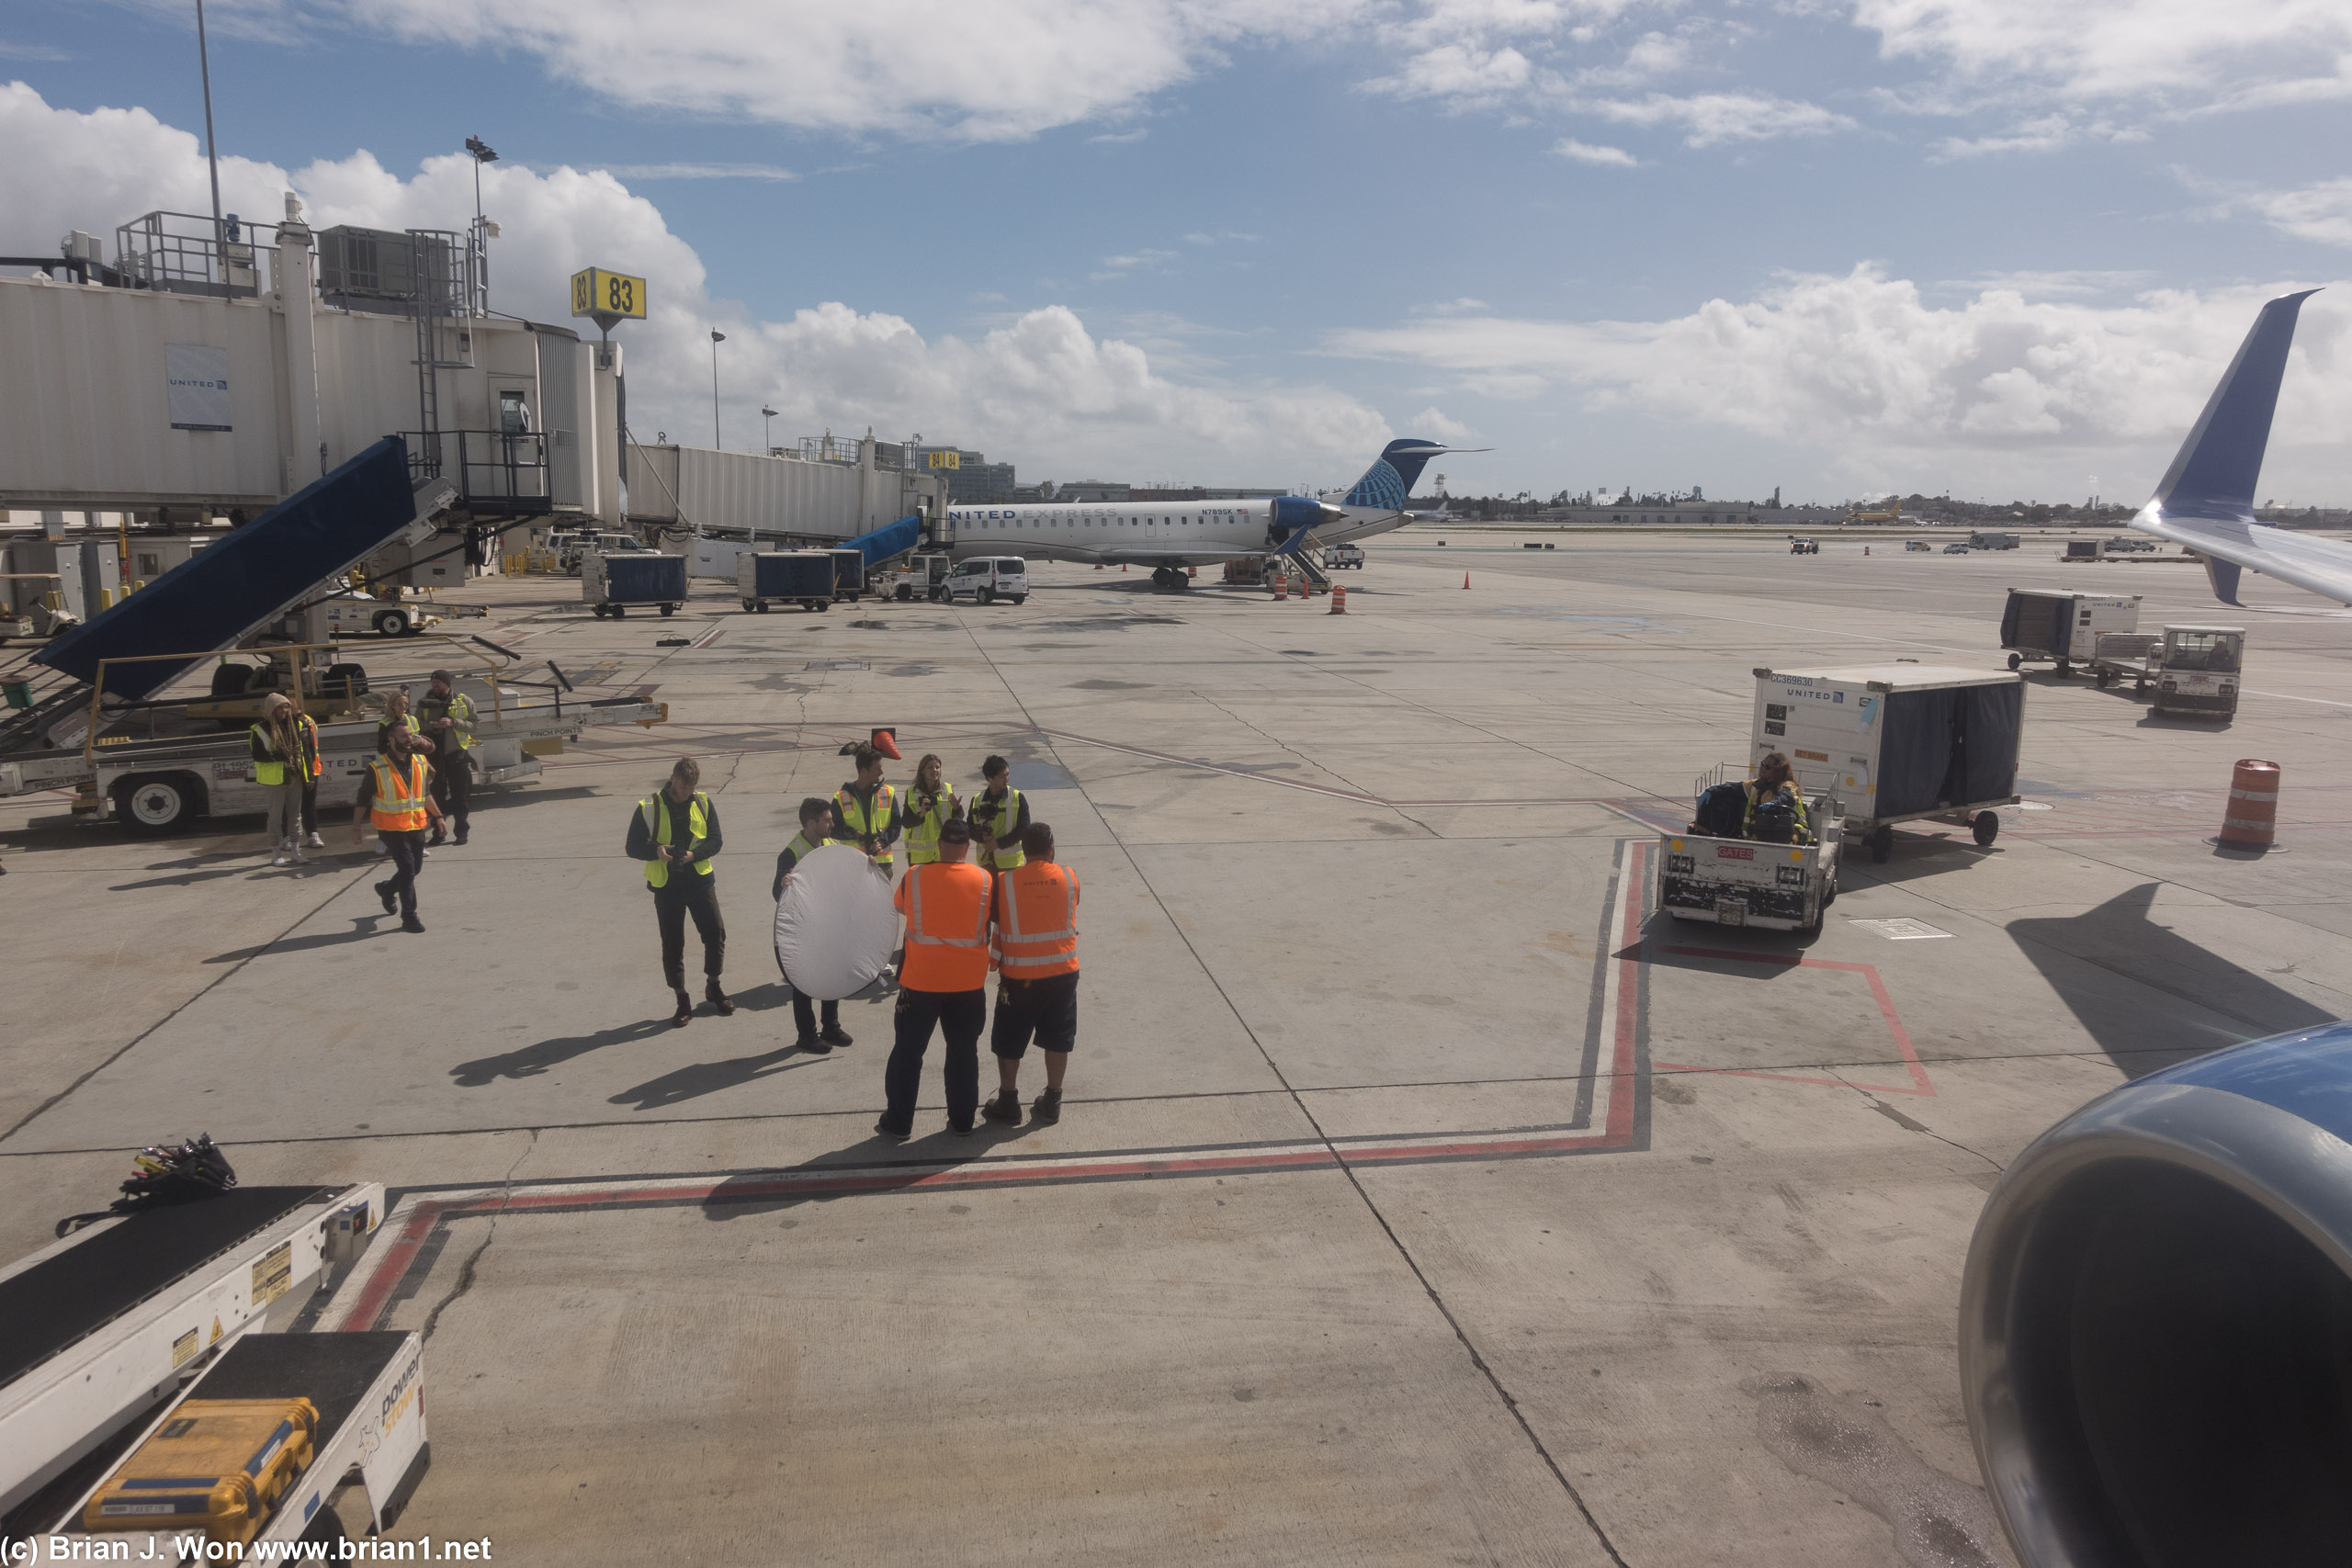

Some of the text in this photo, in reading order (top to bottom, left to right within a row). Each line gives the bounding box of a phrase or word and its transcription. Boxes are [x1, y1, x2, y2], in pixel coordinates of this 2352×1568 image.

[576, 275, 587, 310] 83
[609, 276, 633, 313] 83
[169, 378, 214, 388] UNITED
[932, 452, 940, 467] 84
[948, 453, 956, 468] 84
[948, 508, 1118, 521] NITED EXPRESS
[1770, 672, 1813, 687] CC369630
[1787, 688, 1830, 700] UNITED
[530, 727, 582, 738] PINCH POINTS
[324, 759, 357, 768] TED
[35, 773, 96, 788] PINCH POINT
[1718, 847, 1753, 859] GATES
[271, 1275, 288, 1292] FALLING
[382, 1349, 422, 1427] power
[385, 1377, 418, 1438] stow
